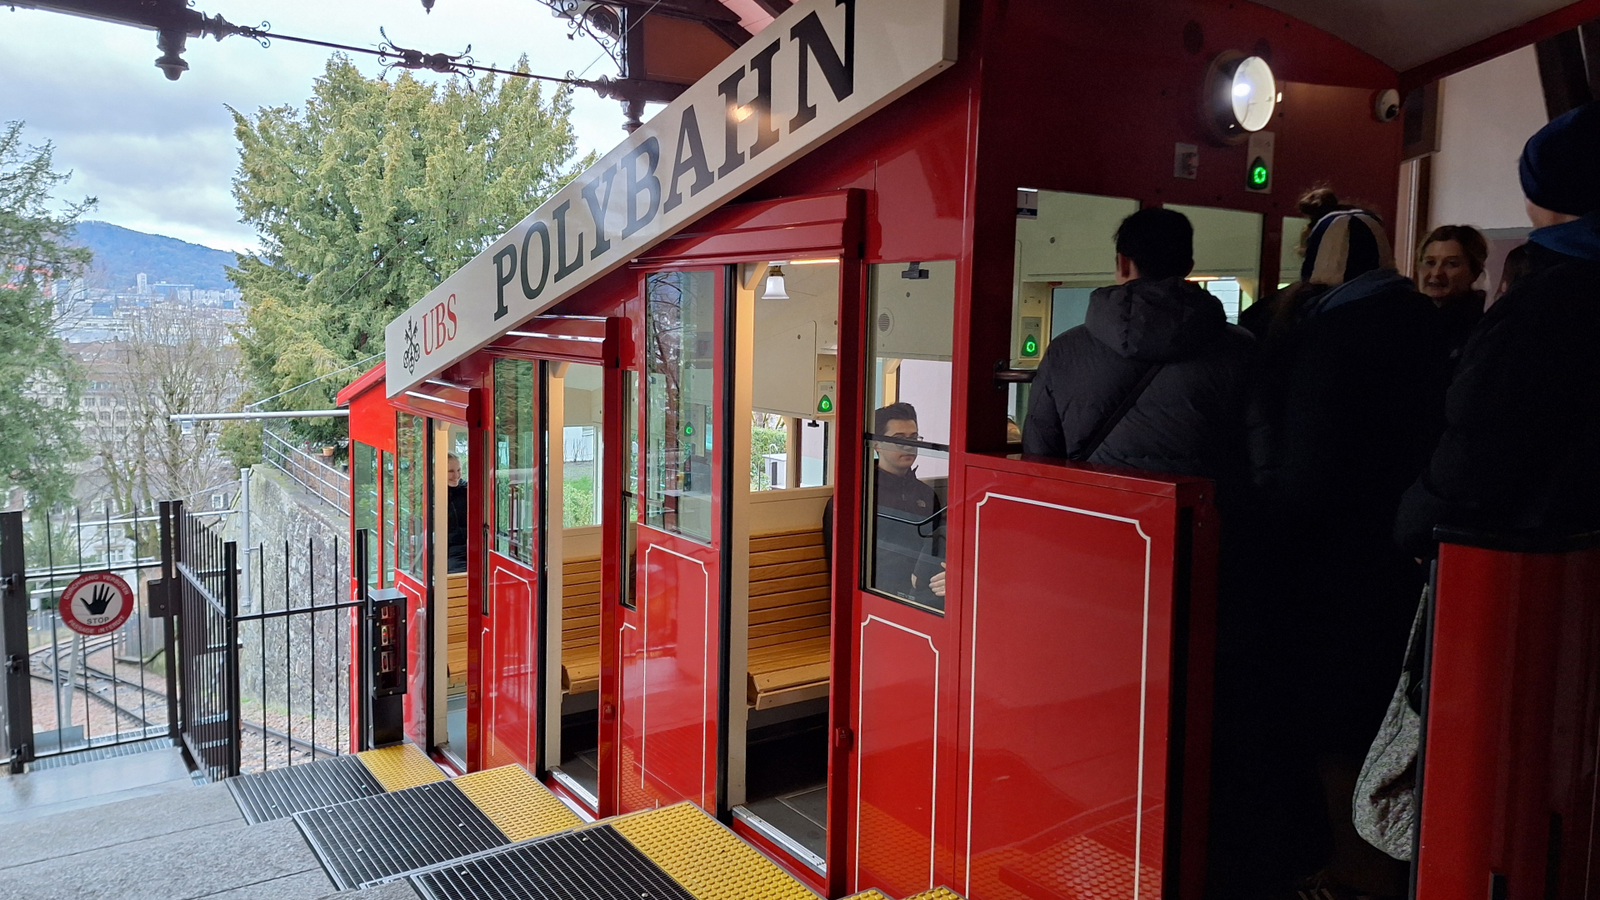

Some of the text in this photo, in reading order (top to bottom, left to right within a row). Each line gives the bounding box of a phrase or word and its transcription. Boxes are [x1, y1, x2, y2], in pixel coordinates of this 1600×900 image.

[422, 0, 856, 355] UBS POLYBAHN
[63, 574, 129, 600] DURCHGANG VERBOTEN
[68, 619, 95, 634] PASSAGE
[86, 616, 110, 625] STOP
